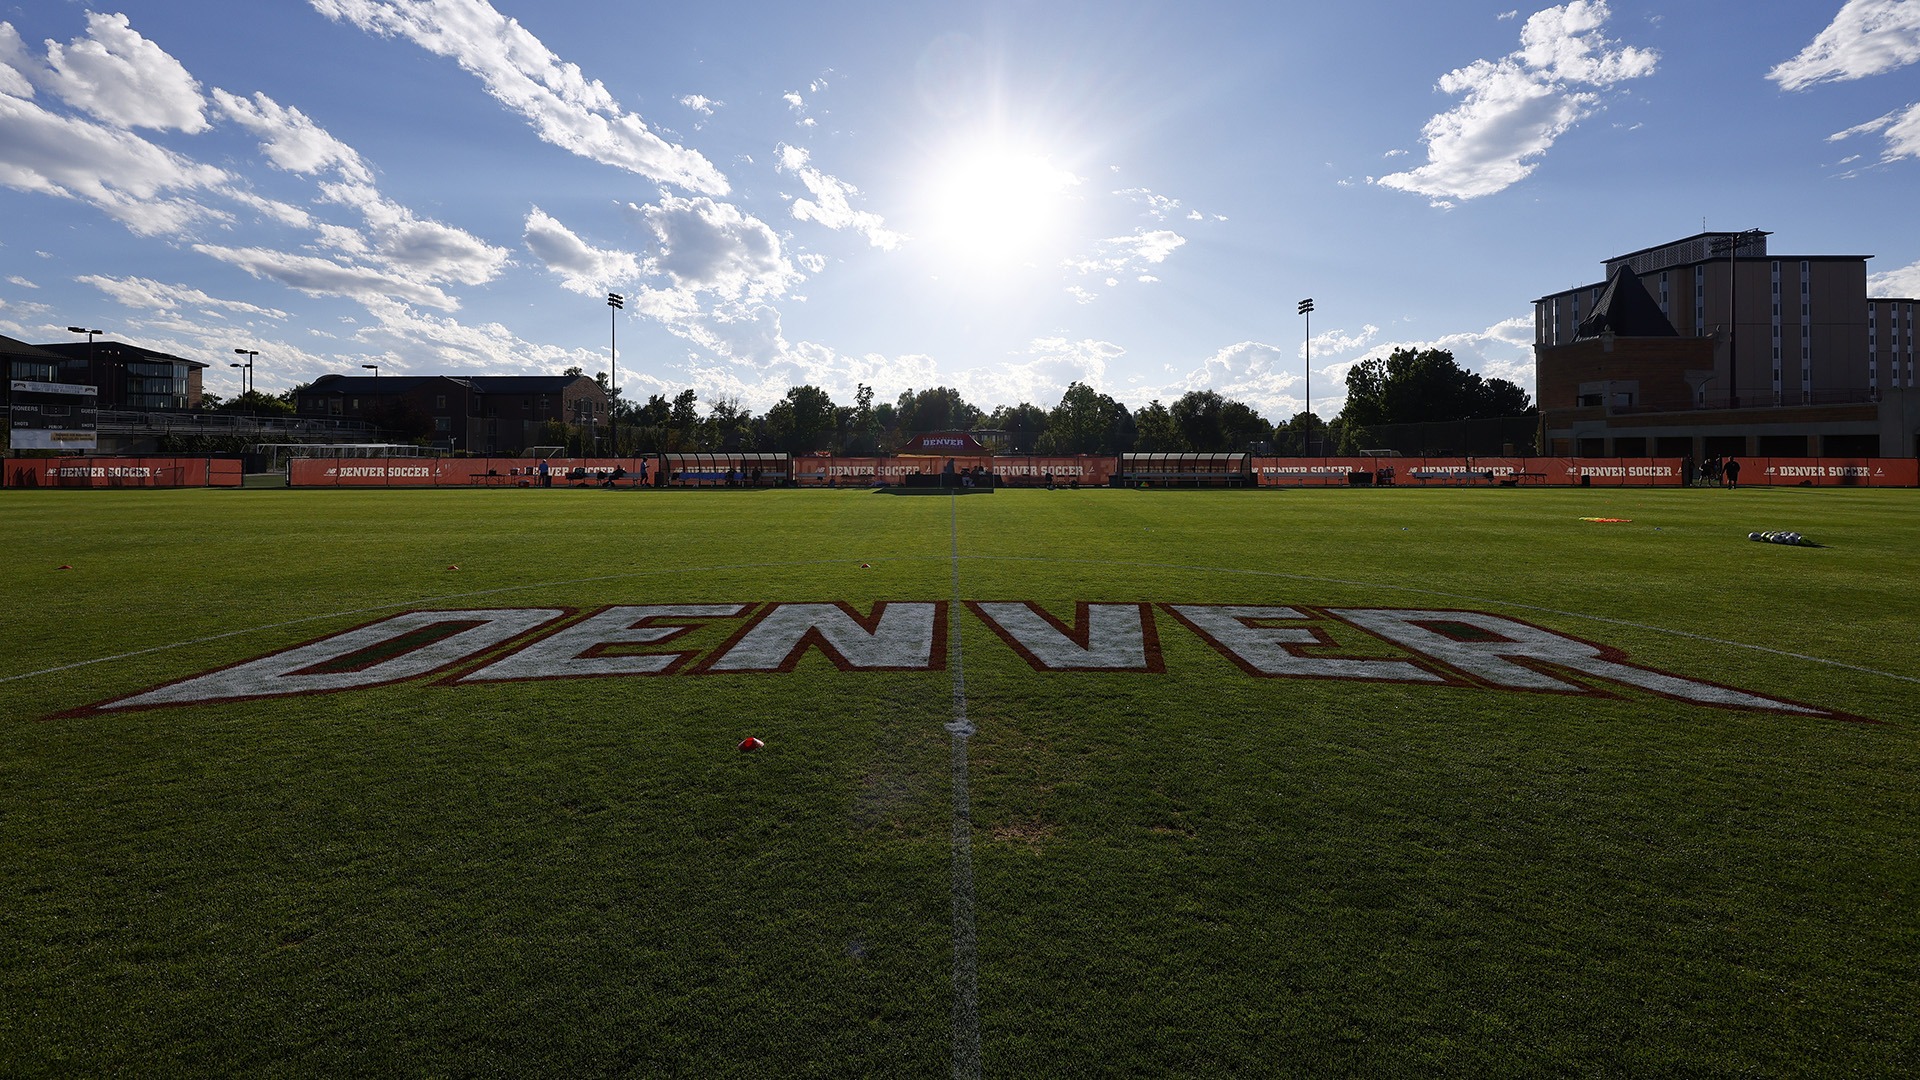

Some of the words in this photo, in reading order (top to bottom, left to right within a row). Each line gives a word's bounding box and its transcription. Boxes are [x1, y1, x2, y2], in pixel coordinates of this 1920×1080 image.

[60, 467, 105, 477] DENVER
[108, 467, 151, 477] SOCCER
[340, 467, 385, 477] DENVER
[388, 467, 429, 477] SOCCER
[829, 466, 875, 476] DENVER
[878, 466, 920, 476] SOCCER
[993, 466, 1038, 476] DENVER
[1041, 466, 1083, 476] SOCCER
[1263, 466, 1308, 474] DENVER
[1311, 466, 1353, 476] SOCCER
[1421, 466, 1467, 474] DENVER
[1581, 466, 1626, 477] DENVER
[1629, 466, 1672, 477] SOCCER
[1780, 466, 1826, 477] DENVER
[1829, 466, 1870, 477] SOCCER
[38, 600, 1884, 722] DENVER
